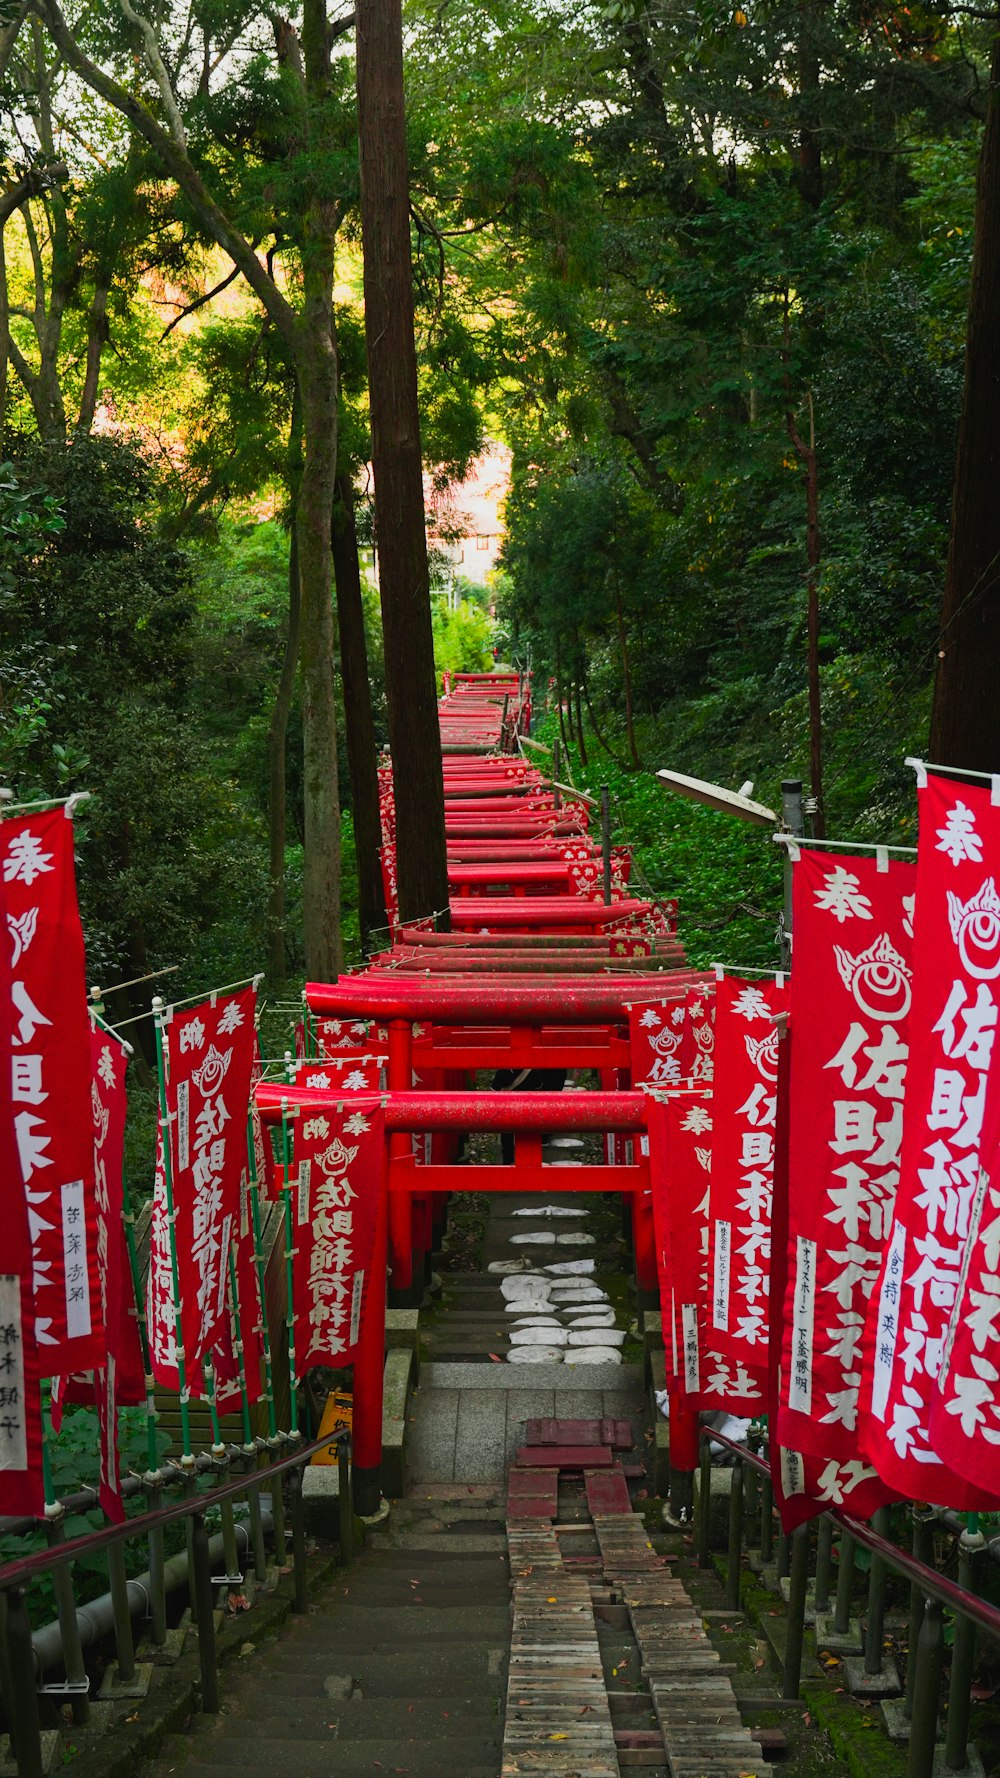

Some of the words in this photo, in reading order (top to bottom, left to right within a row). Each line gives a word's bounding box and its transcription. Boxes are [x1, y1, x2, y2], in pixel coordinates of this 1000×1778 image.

[935, 800, 984, 866] 奉
[731, 986, 772, 1021] 奉
[679, 1105, 713, 1135] 奉
